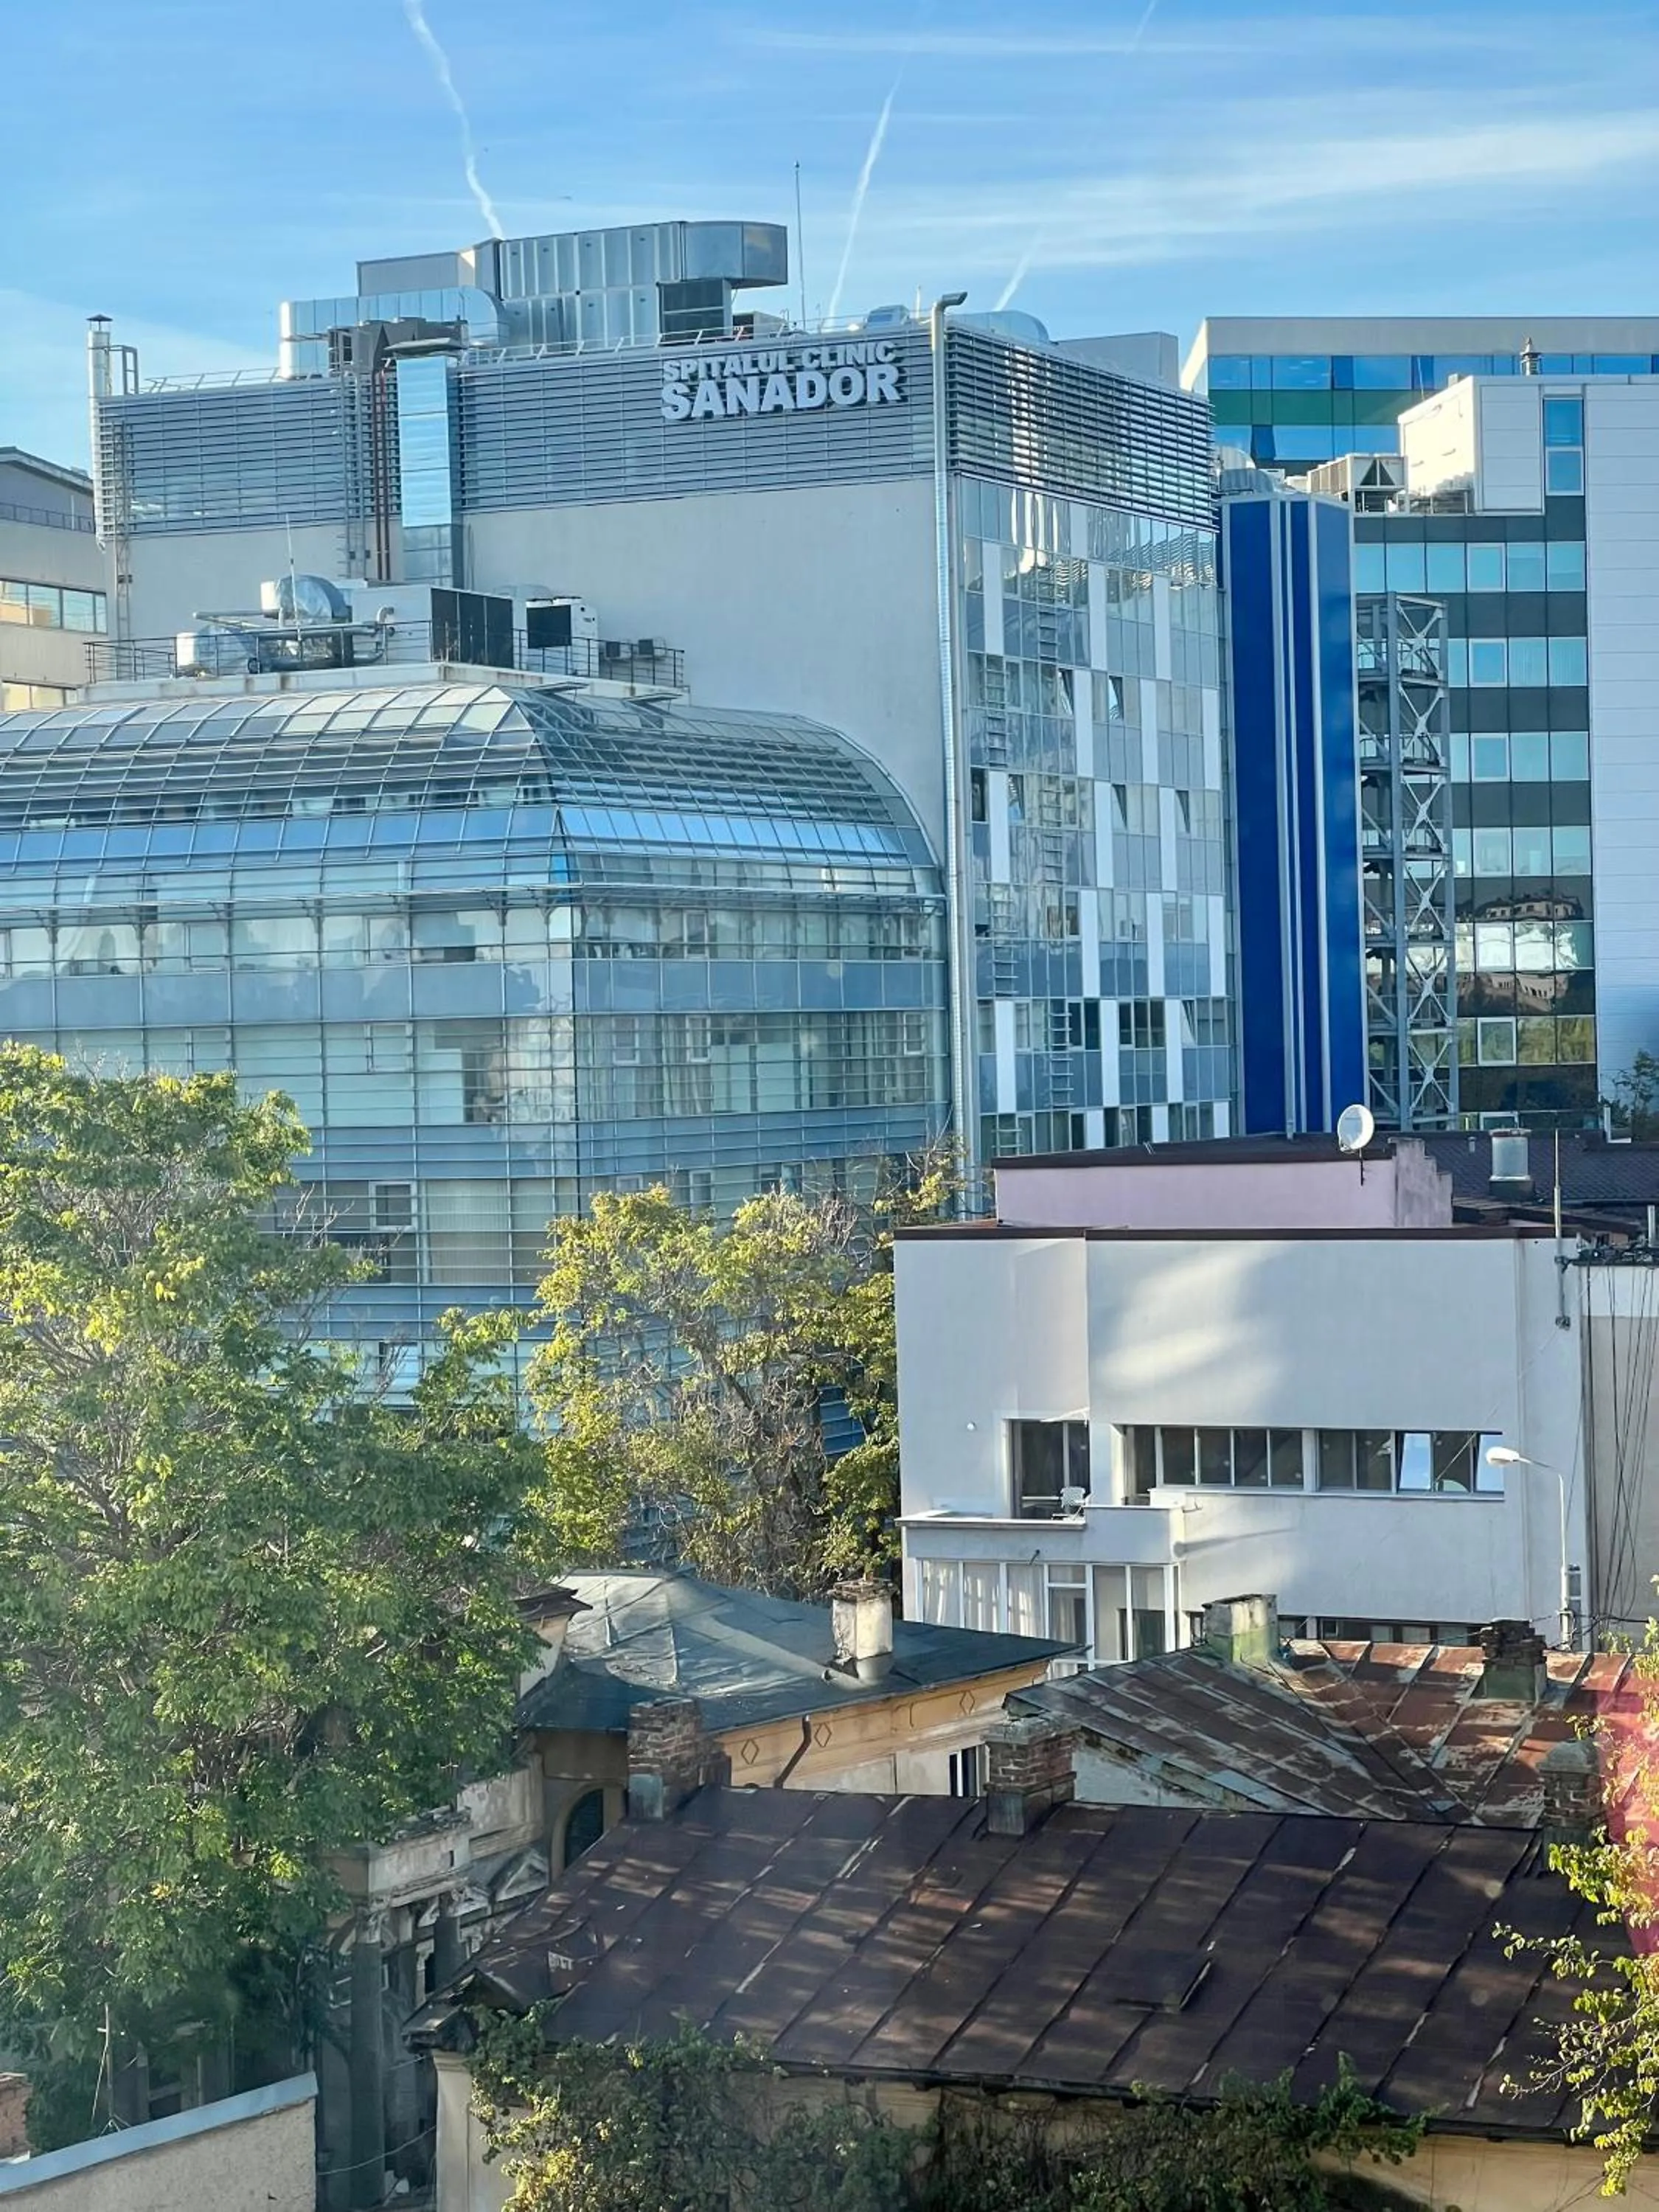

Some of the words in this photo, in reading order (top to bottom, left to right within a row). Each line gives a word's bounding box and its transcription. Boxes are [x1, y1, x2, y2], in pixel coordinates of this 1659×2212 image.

[664, 352, 795, 381] SPITALUL
[802, 341, 896, 368] CLINIC
[662, 364, 901, 420] SANADOR
